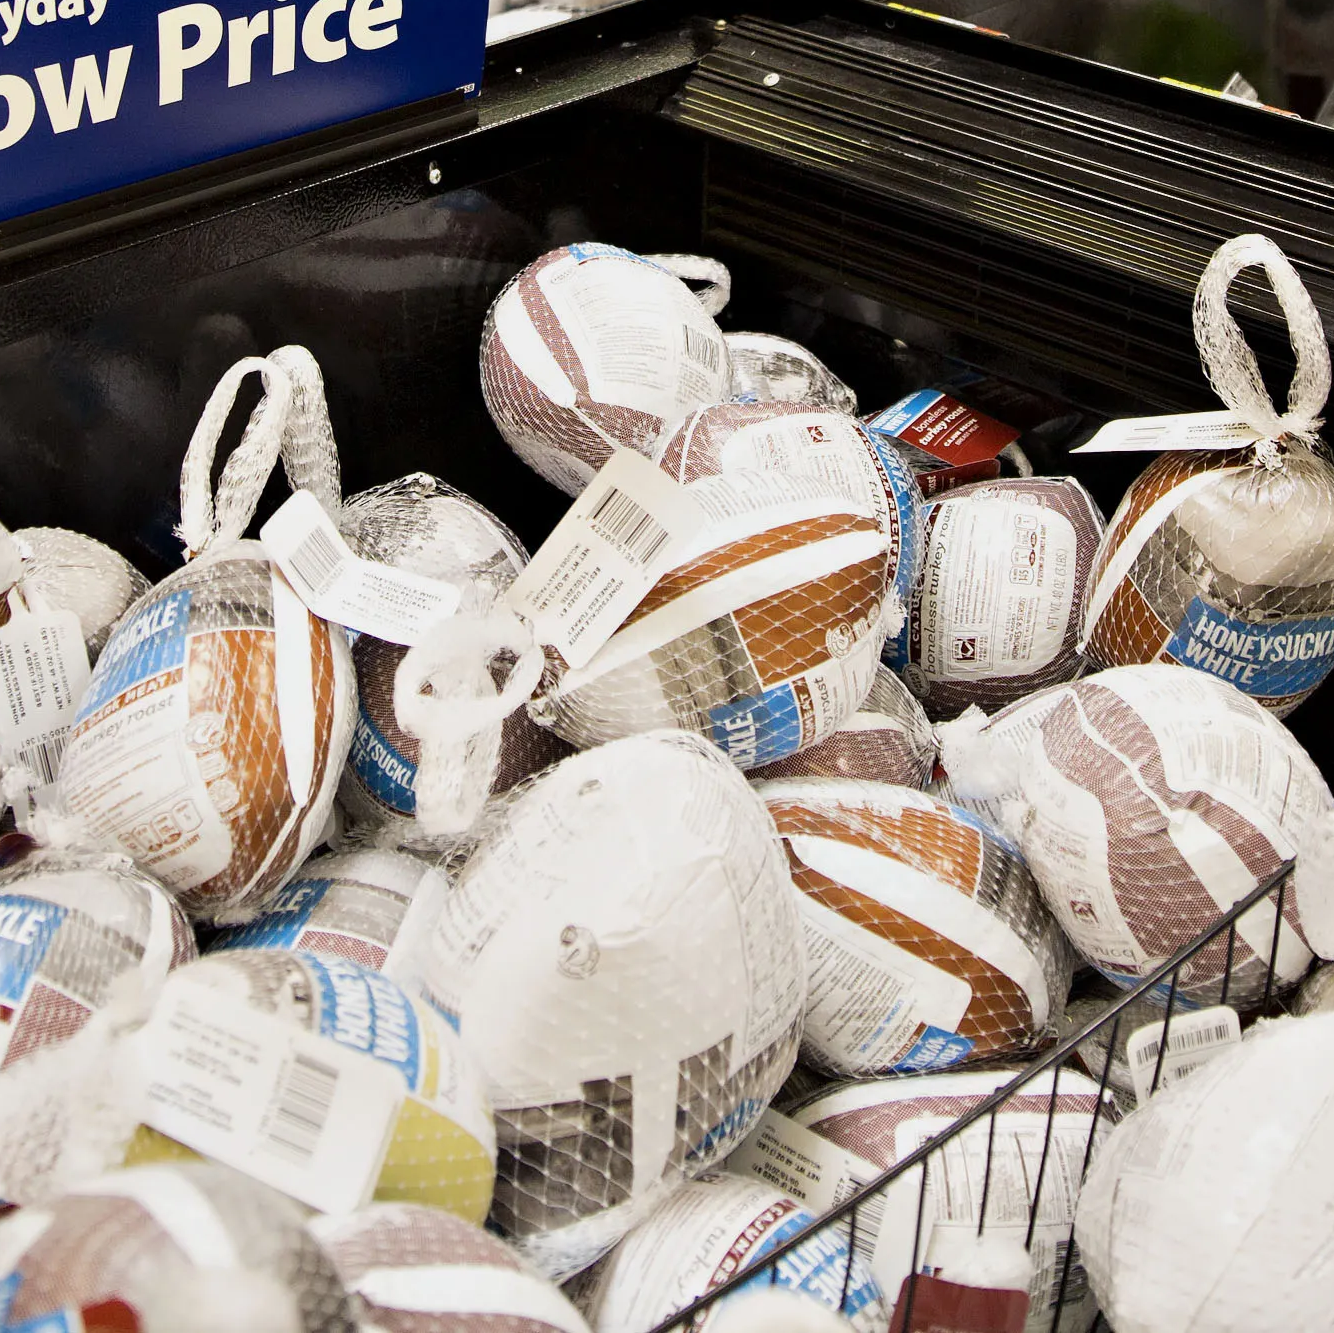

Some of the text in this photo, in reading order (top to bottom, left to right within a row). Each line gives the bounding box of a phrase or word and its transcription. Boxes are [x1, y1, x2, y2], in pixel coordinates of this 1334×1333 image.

[912, 405, 948, 433] boneless
[919, 406, 968, 446] turkey roast
[579, 547, 591, 561] NET
[588, 566, 601, 584] BEST
[924, 504, 954, 675] boneless turkey roast
[568, 578, 616, 635] BONELESS TURKEY
[569, 580, 624, 646] HONEYSUCKLE WHITE
[27, 656, 35, 678] USED
[47, 657, 55, 667] OZ
[1186, 636, 1261, 685] WHITE
[5, 643, 26, 717] BONELESS TURKEY
[2, 668, 19, 725] HONEYSUCKLE
[32, 688, 42, 708] BEST
[56, 694, 64, 710] NET
[81, 694, 175, 751] turkey roast
[775, 1152, 785, 1162] OZ
[763, 1171, 780, 1186] USED
[806, 1168, 821, 1183] NET
[787, 1186, 806, 1200] BEST
